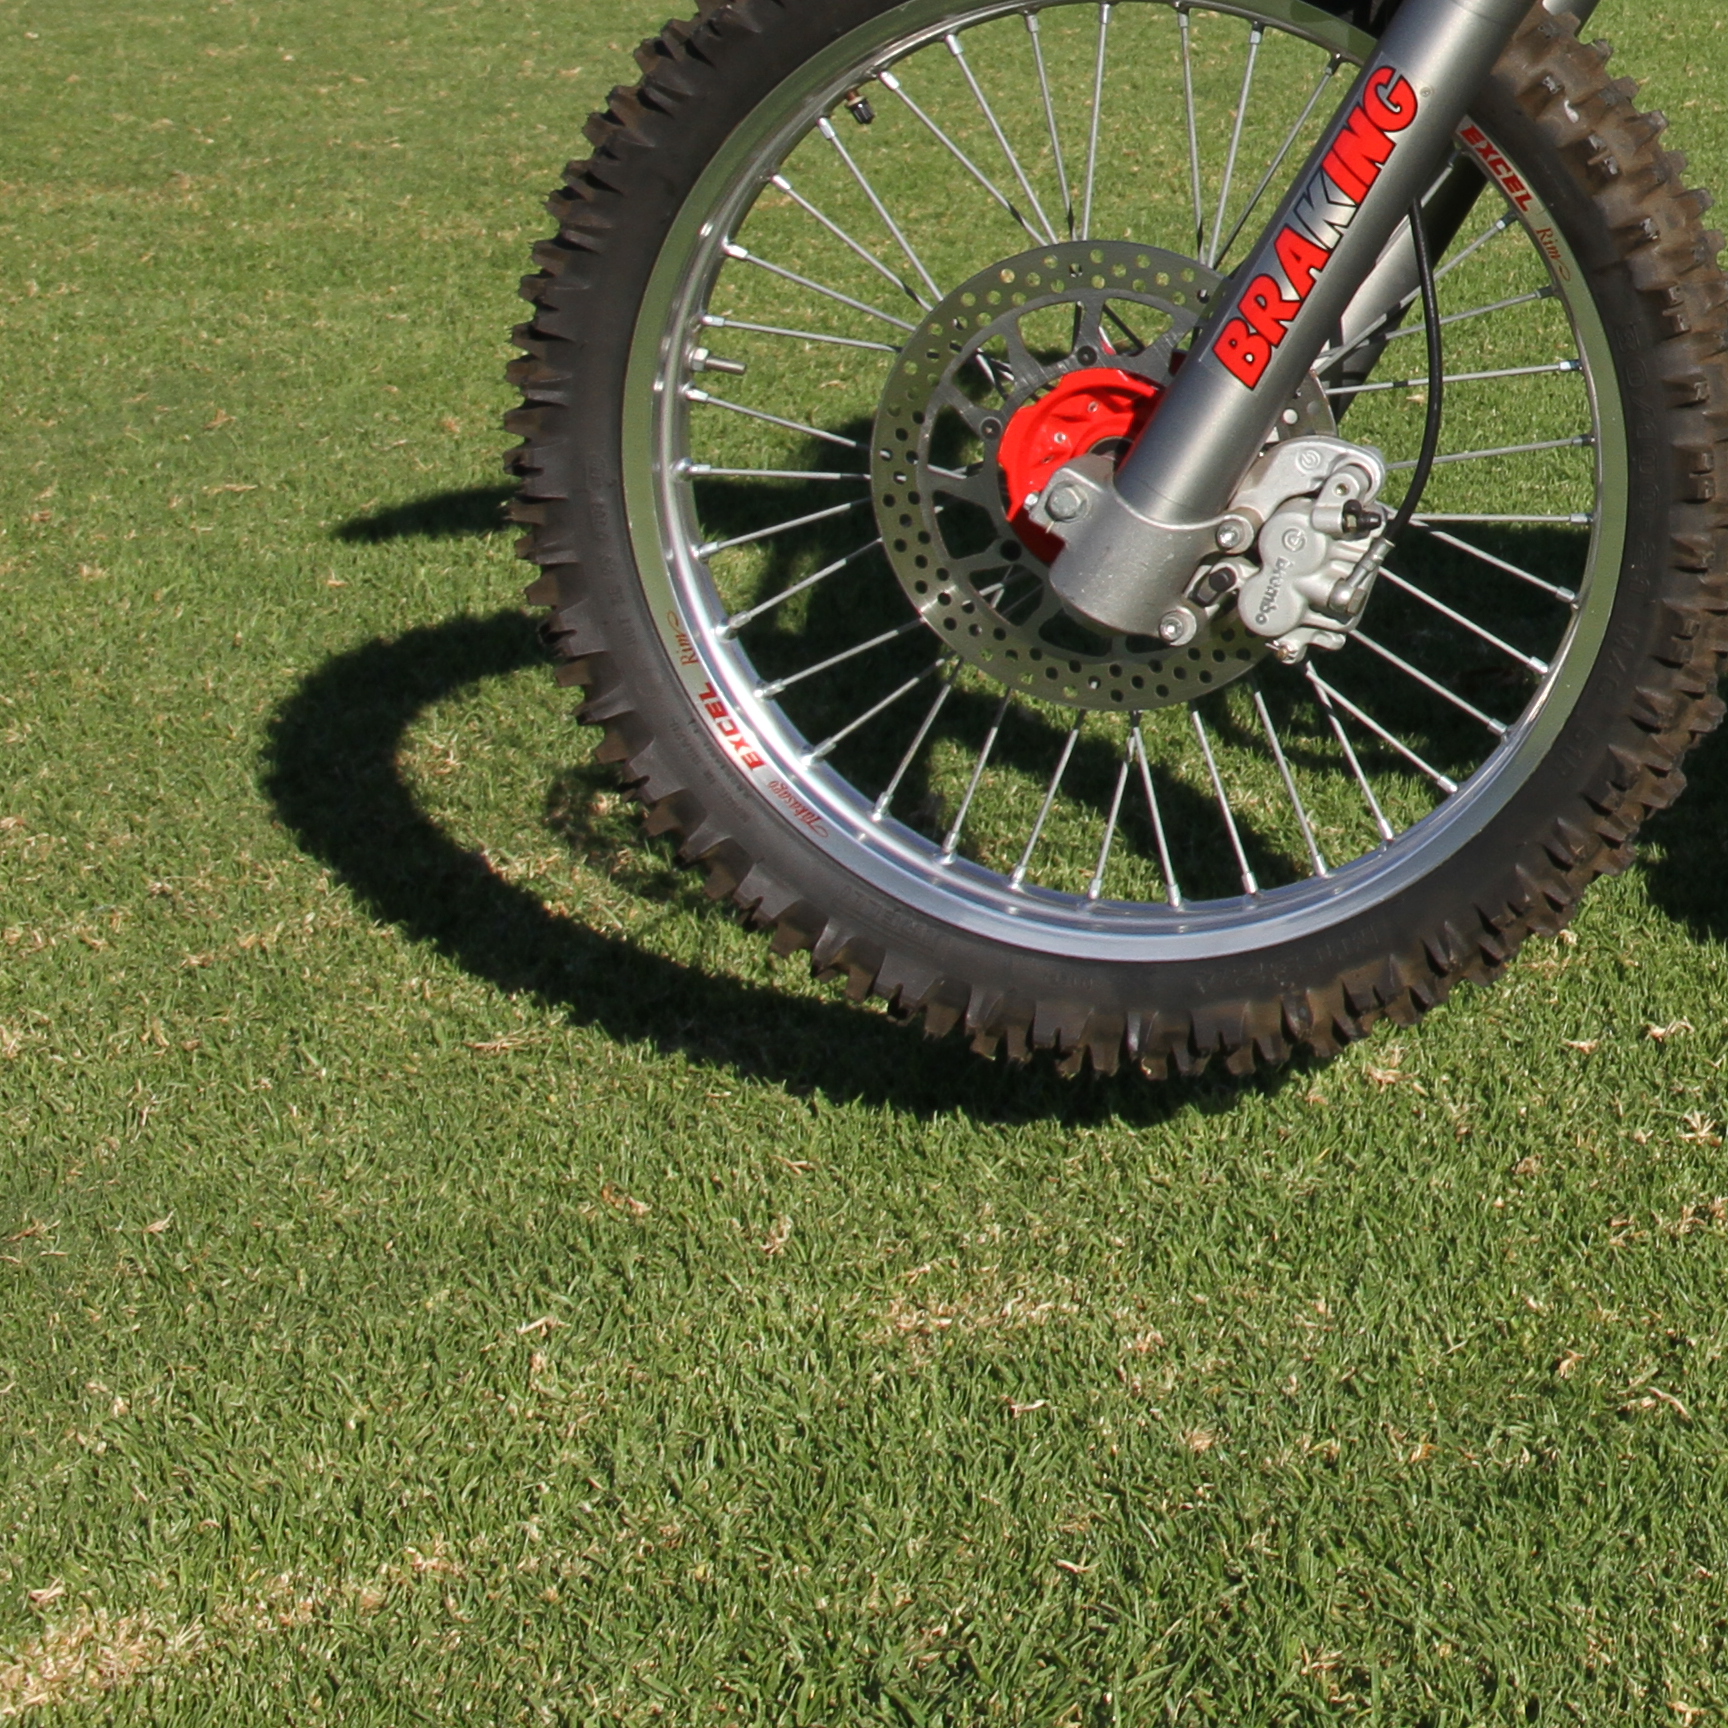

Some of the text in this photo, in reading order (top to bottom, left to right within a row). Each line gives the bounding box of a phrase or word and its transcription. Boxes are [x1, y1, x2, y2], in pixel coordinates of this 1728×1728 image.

[1461, 125, 1532, 212] EXCEL
[1212, 66, 1418, 390] BRAKING
[1256, 556, 1287, 627] brembo
[699, 680, 766, 772] EXCEL
